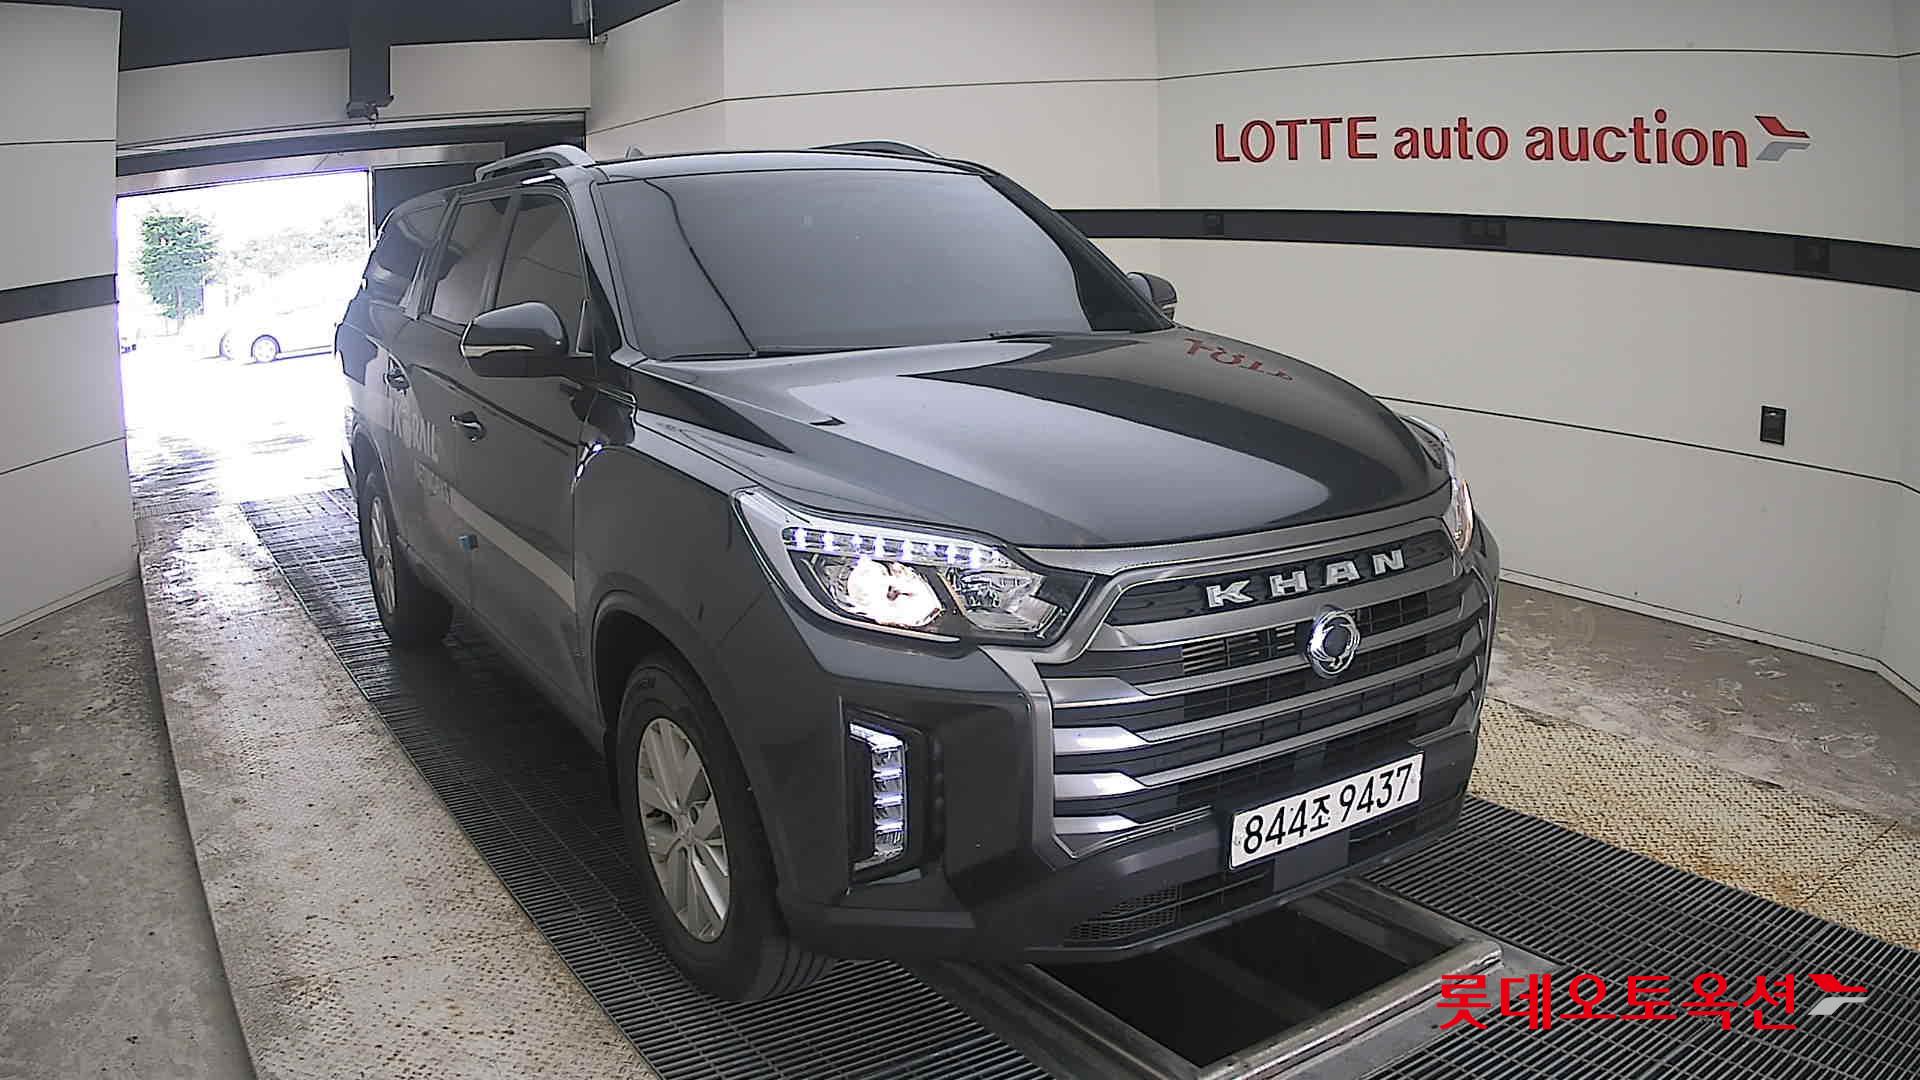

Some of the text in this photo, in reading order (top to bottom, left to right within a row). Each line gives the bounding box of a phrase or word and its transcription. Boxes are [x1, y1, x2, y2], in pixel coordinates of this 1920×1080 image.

[1214, 108, 1749, 168] LOTTE auto auction
[1205, 549, 1406, 609] KHAN
